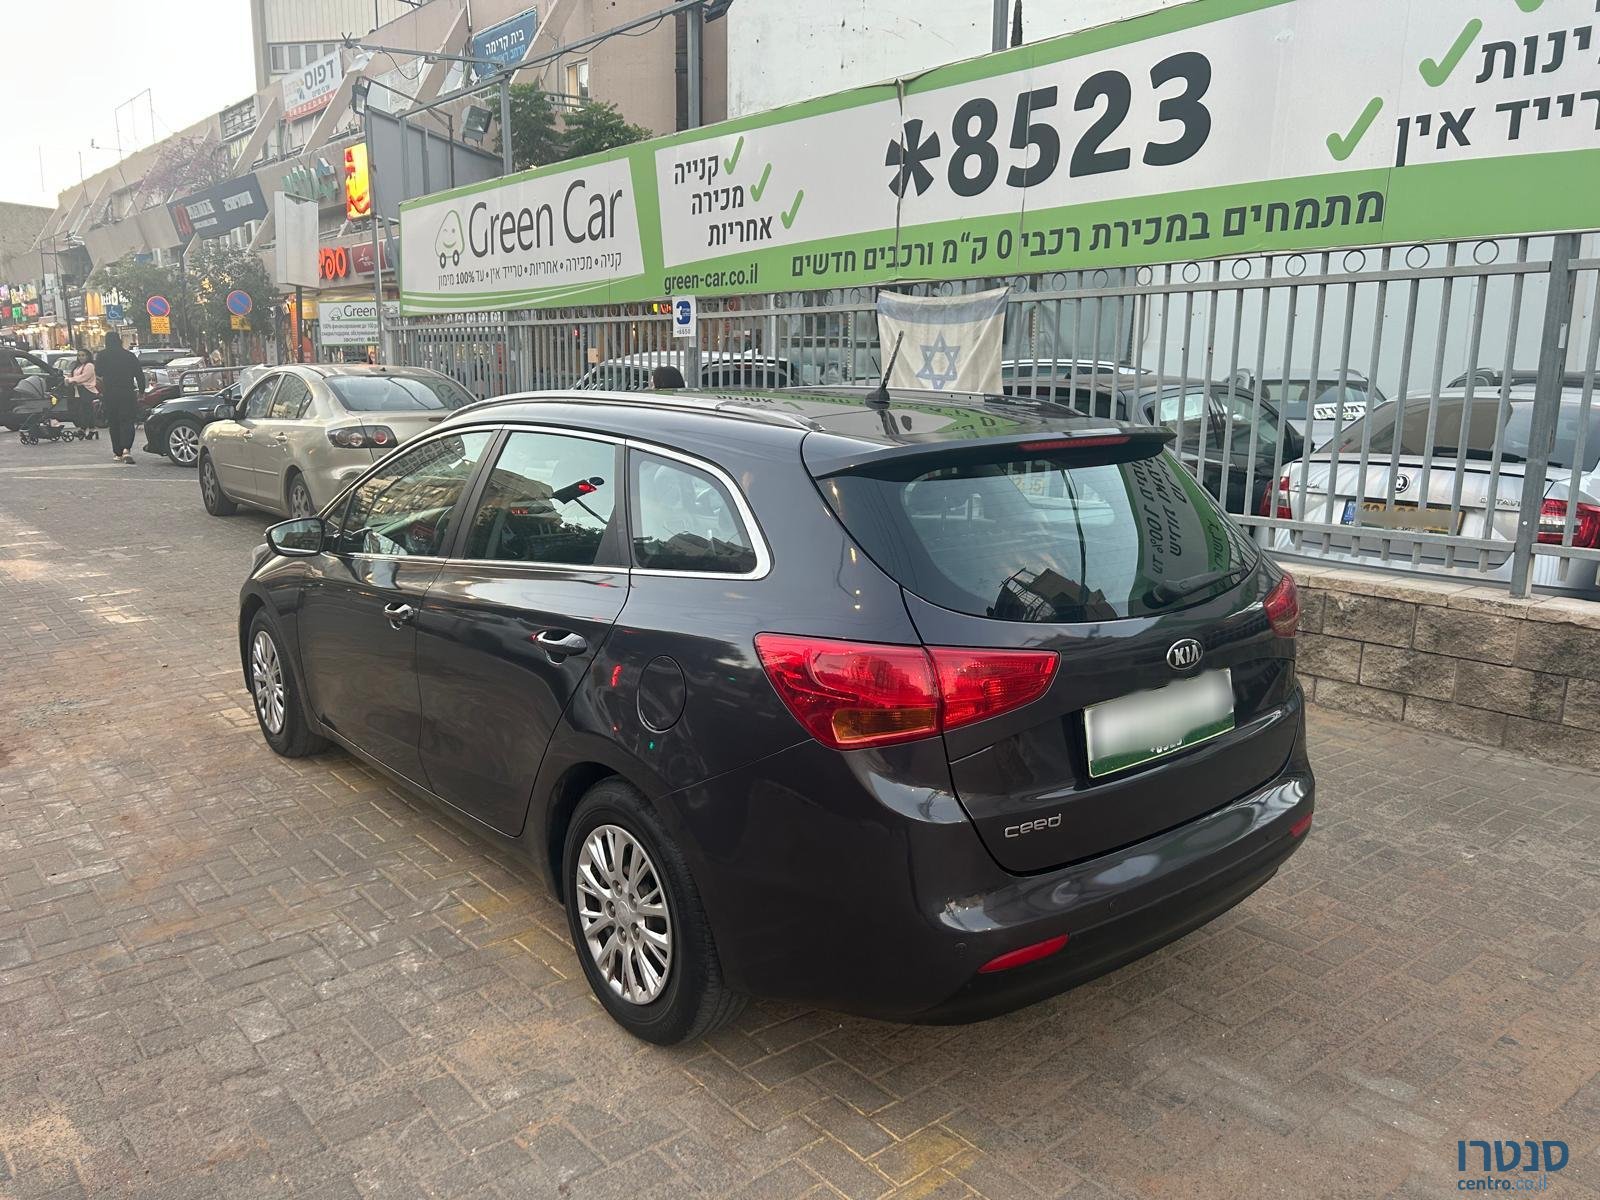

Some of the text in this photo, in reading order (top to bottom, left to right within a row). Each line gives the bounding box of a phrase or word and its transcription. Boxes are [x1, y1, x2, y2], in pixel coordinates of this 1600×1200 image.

[1475, 25, 1600, 84] ינות
[304, 59, 334, 90] דפוס
[1395, 107, 1477, 168] אין
[674, 155, 719, 186] קנייה
[691, 185, 745, 215] מכירה
[1222, 190, 1385, 237] מתמחים
[468, 179, 623, 258] Green Car
[707, 216, 773, 247] אחריות
[1089, 211, 1211, 251] במכירת
[863, 241, 933, 270] ורכבים
[1021, 226, 1080, 257] רכבי
[438, 251, 622, 290] קניה מכירה אחריות טרייד אין עד 100% מימון
[664, 262, 758, 295] green-car.co.il
[792, 250, 856, 277] חדשים
[344, 305, 376, 317] Green
[1173, 644, 1200, 666] KIA
[1004, 813, 1062, 839] ceed
